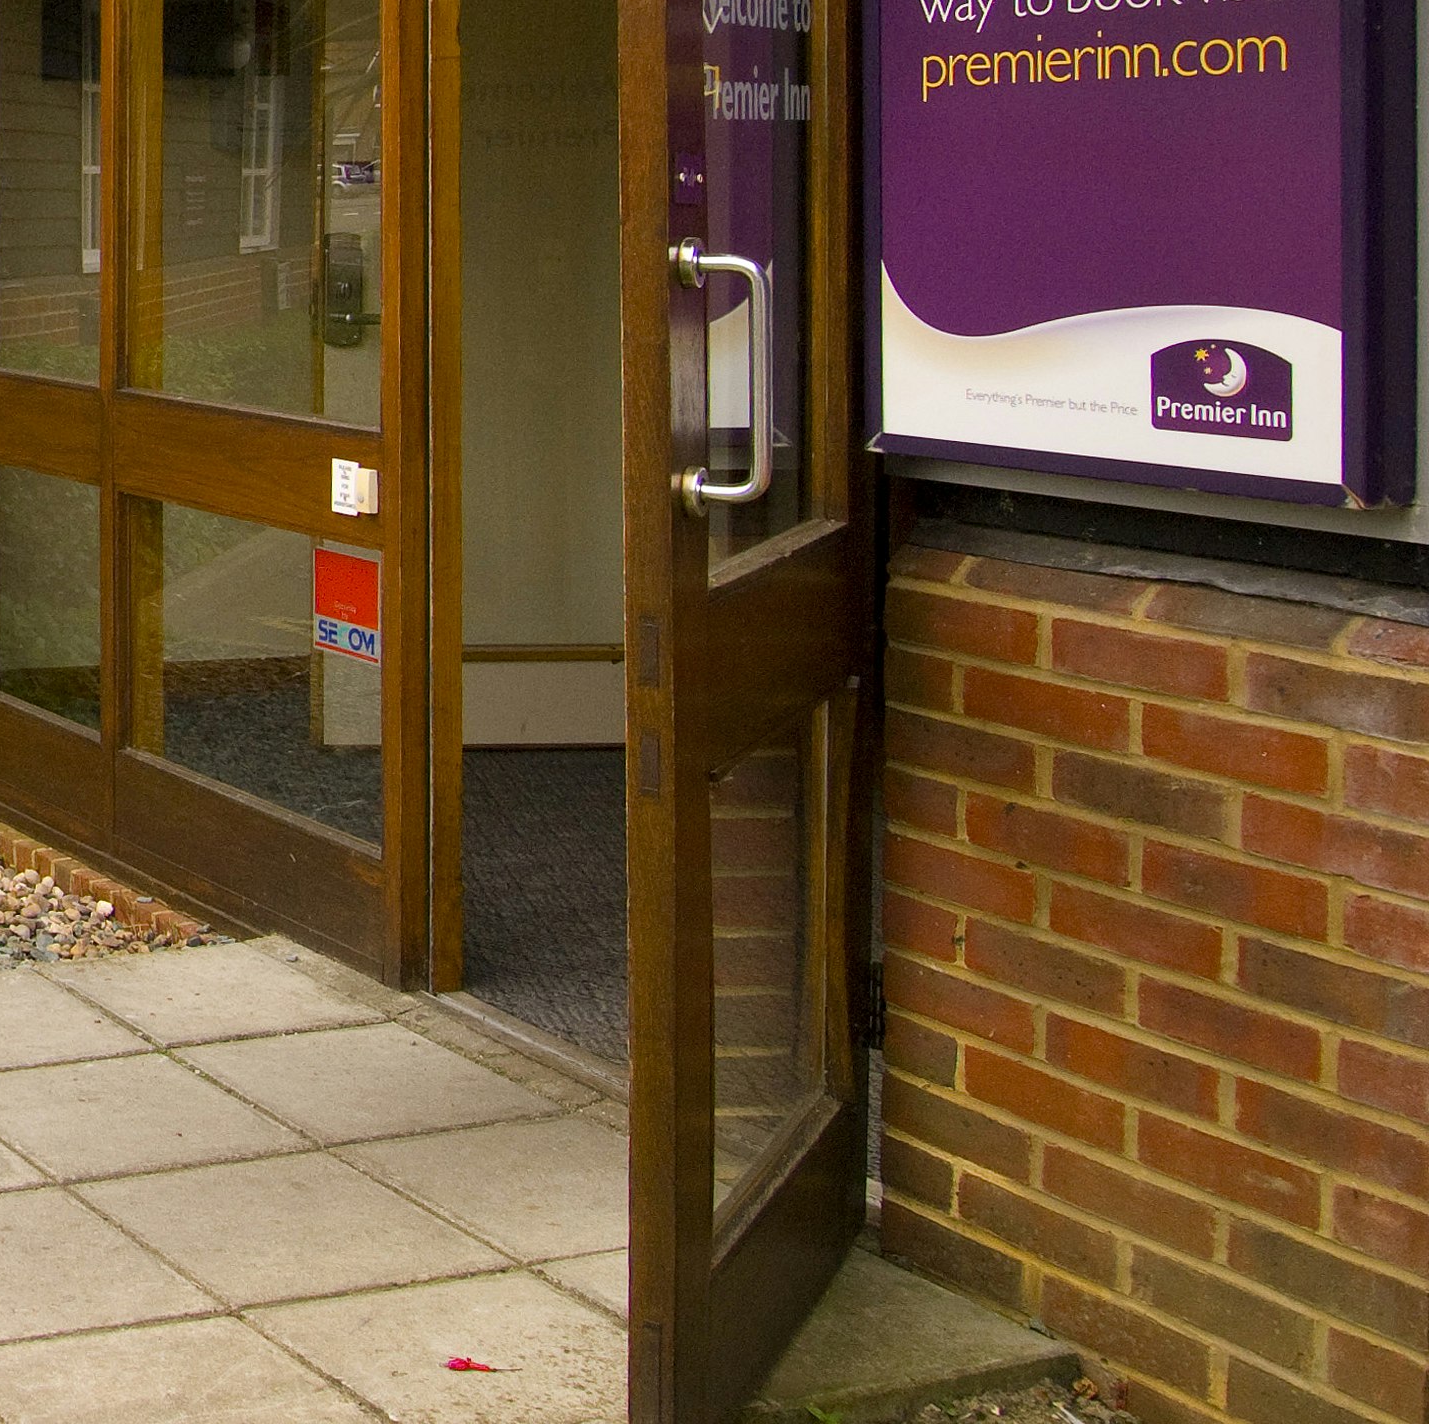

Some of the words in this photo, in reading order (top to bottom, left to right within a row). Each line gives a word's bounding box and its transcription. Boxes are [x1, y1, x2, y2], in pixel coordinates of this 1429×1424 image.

[921, 30, 1288, 103] premierinn.com
[784, 67, 811, 121] Inn
[965, 388, 1023, 408] Everything's
[1025, 394, 1066, 409] Premier
[1068, 398, 1086, 412] but
[1090, 400, 1108, 413] the
[1110, 401, 1138, 416] Price
[1157, 396, 1247, 425] Premier
[1250, 403, 1287, 429] Inn
[318, 619, 375, 656] SECOM
